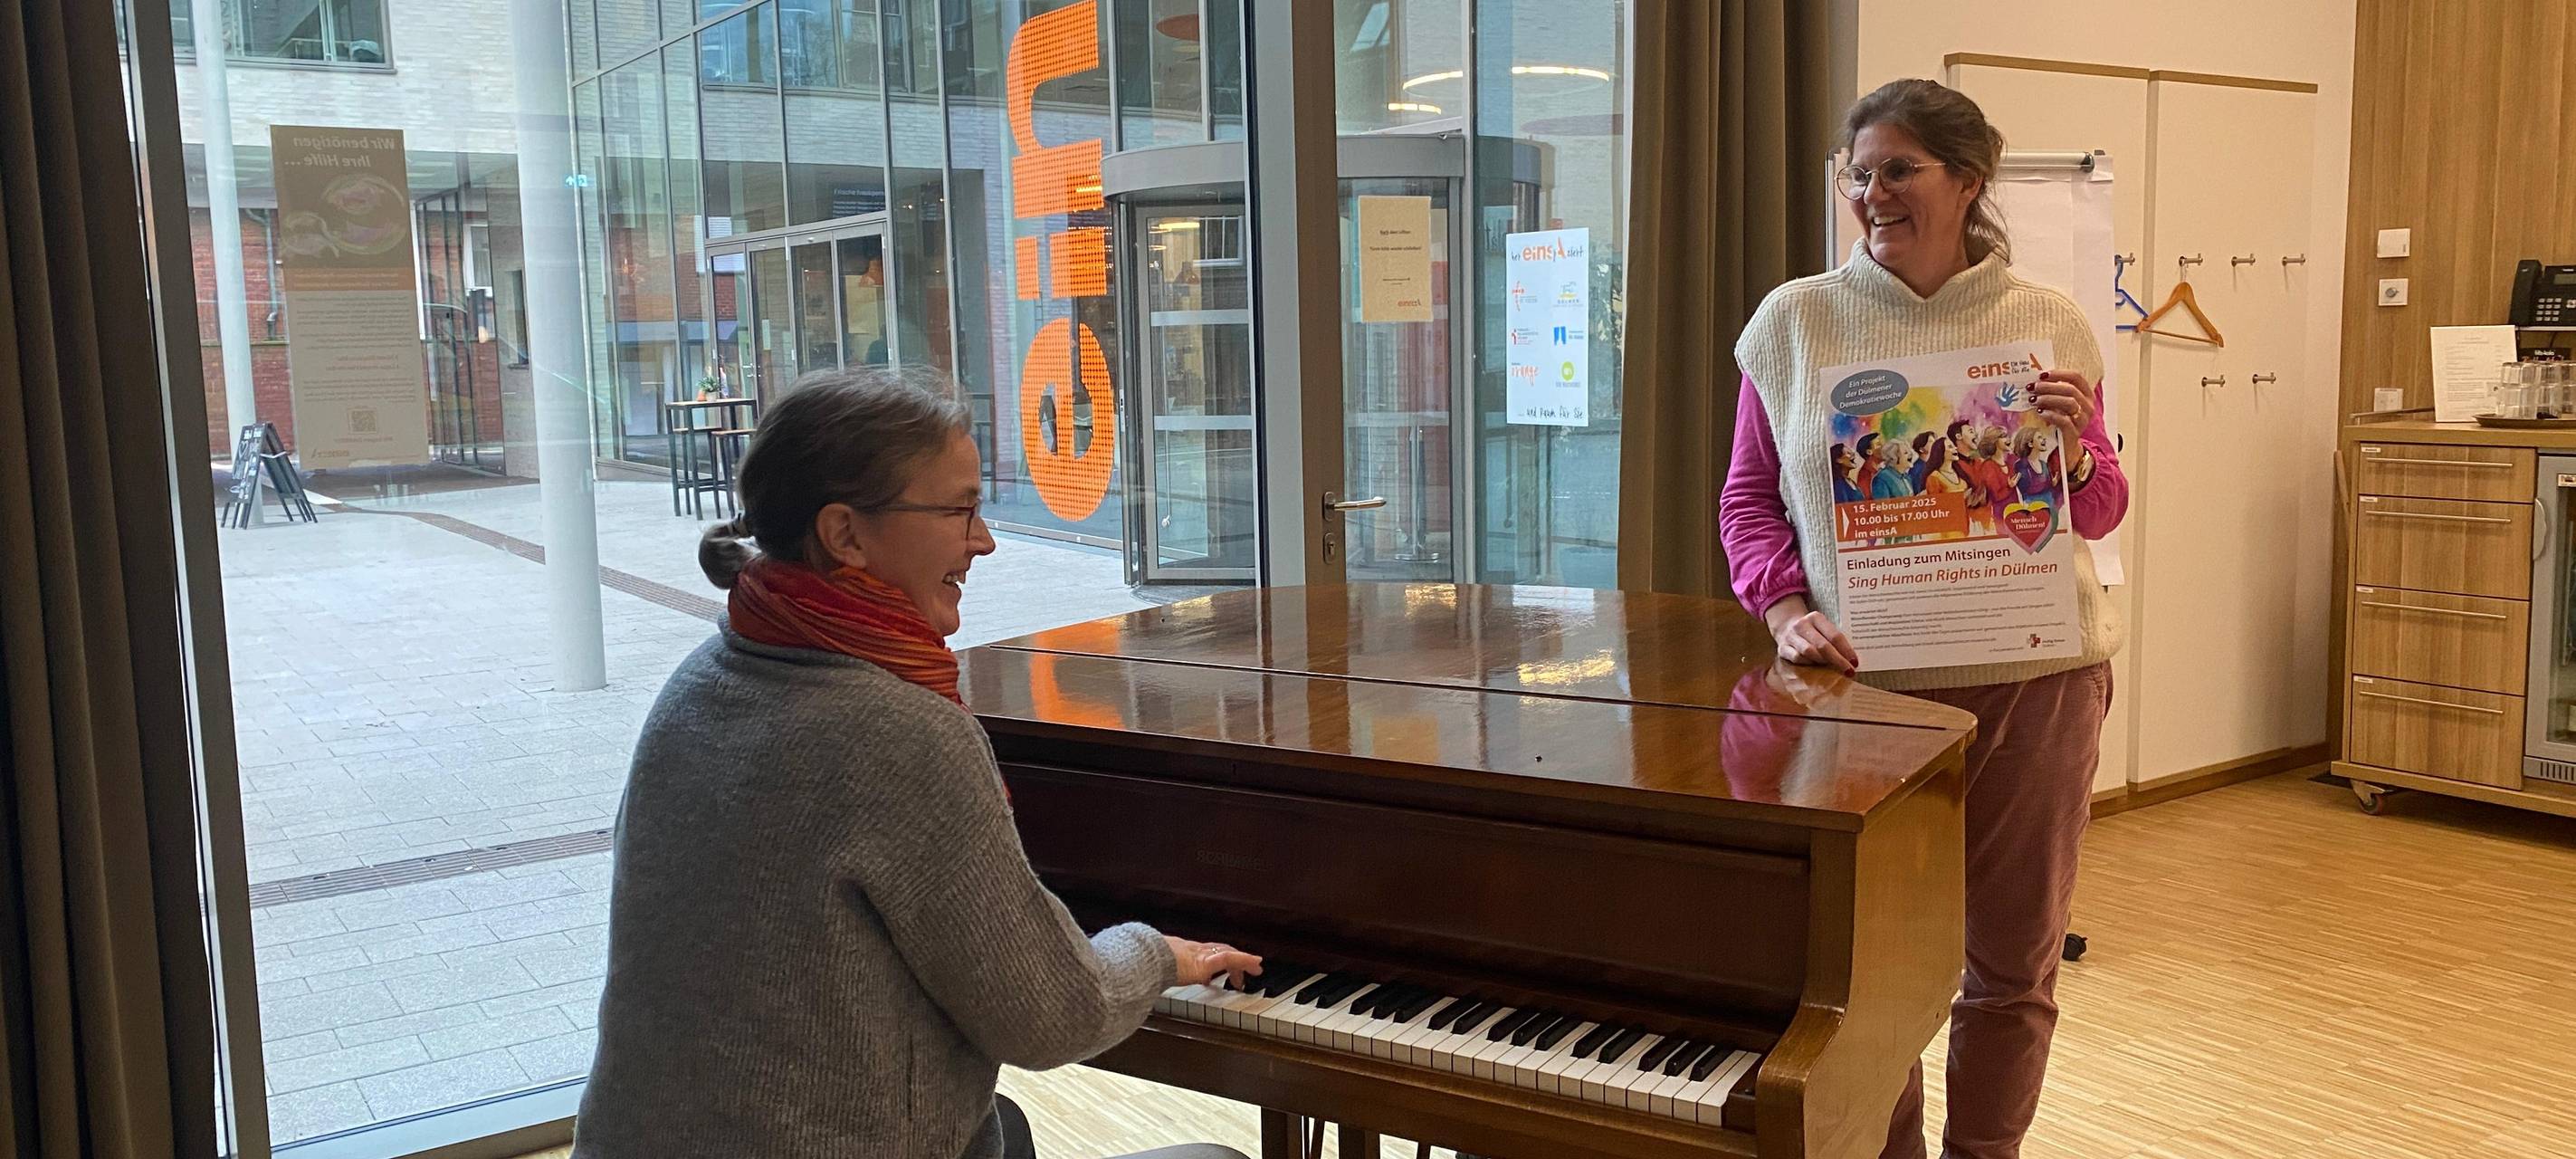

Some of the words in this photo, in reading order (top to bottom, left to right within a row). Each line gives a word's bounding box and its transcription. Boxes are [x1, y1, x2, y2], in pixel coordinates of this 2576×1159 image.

[1848, 380, 1860, 388] Ein
[1860, 375, 1886, 386] Projekt
[1846, 390, 1857, 398] der
[1853, 504, 1868, 513] 15.
[1870, 500, 1910, 512] Februar
[1912, 497, 1937, 508] 2025
[1854, 515, 1882, 526] 10.00
[1884, 513, 1899, 523] bis
[1901, 511, 1929, 522] 17.00
[1931, 509, 1951, 519] Uhr
[2010, 515, 2037, 524] Mensch
[1855, 530, 1867, 539] im
[1869, 526, 1898, 537] einsA
[1846, 554, 1912, 570] Einladung
[1913, 553, 1942, 564] zum
[1945, 548, 2011, 562] Mitsingen
[1847, 576, 1878, 589] Sing
[1881, 571, 1933, 587] Human
[1936, 567, 1981, 583] Rights
[1984, 565, 1998, 580] in
[2000, 561, 2058, 577] Dülmen
